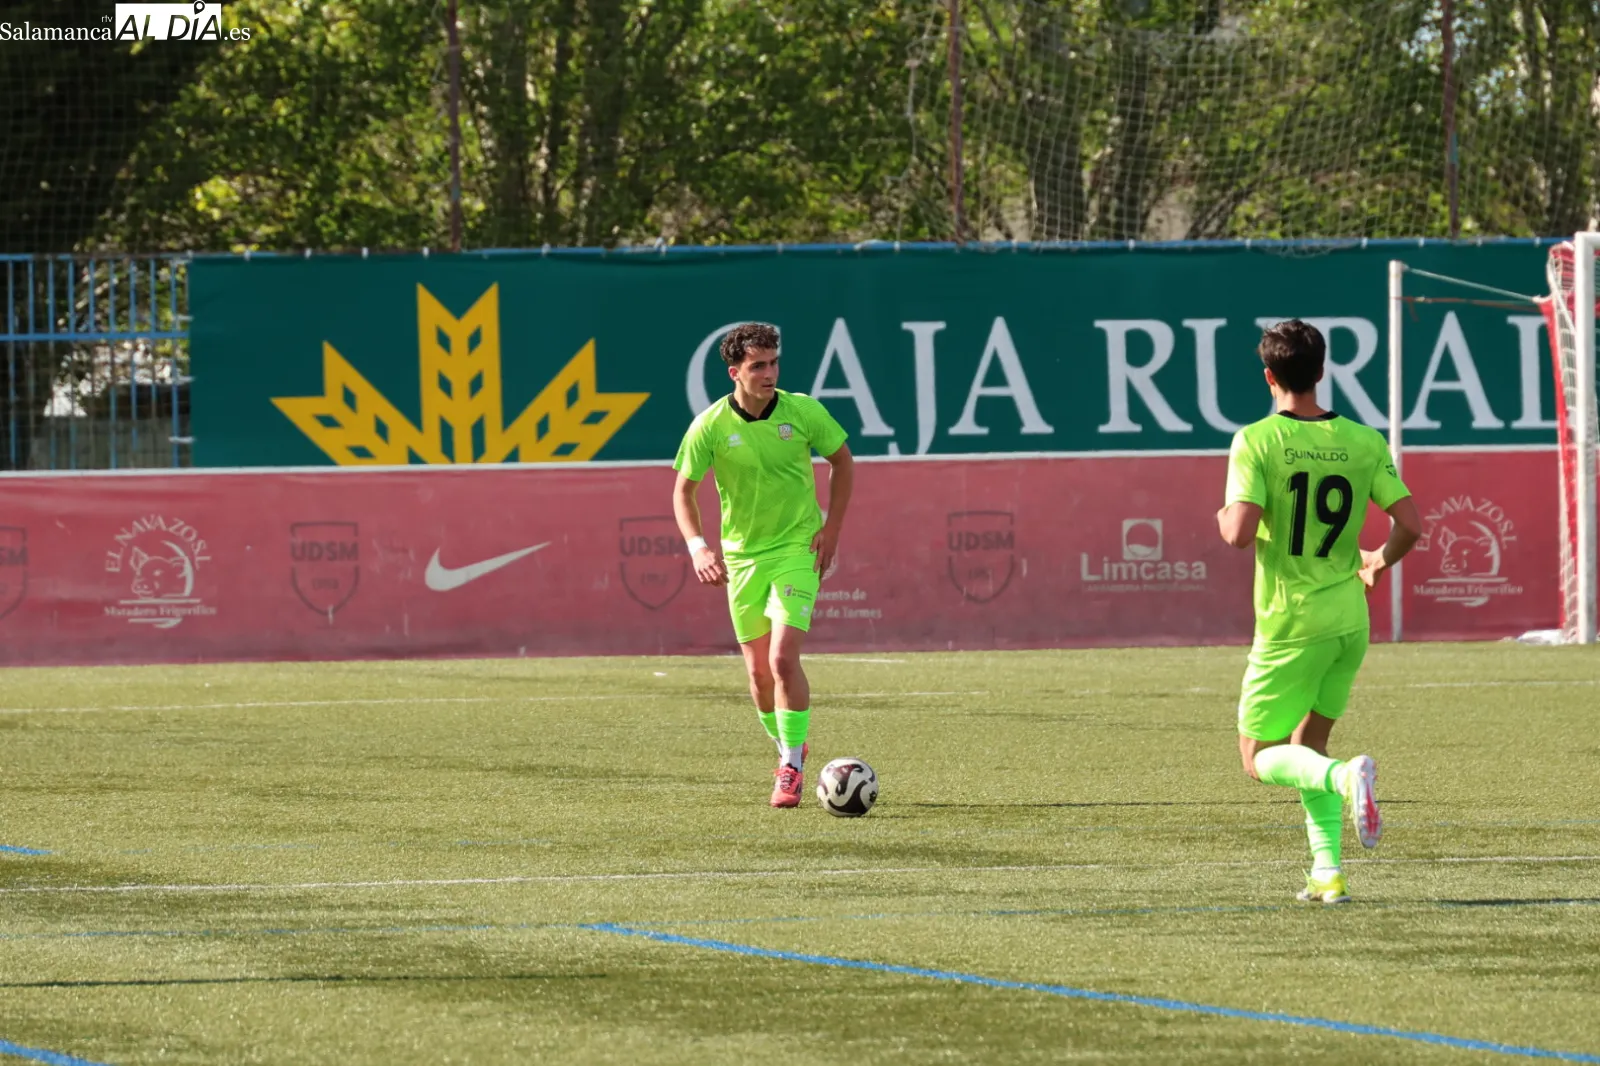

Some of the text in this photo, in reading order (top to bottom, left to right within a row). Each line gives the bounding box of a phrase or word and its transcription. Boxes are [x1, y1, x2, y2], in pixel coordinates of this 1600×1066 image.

[1289, 472, 1354, 558] 19
[290, 541, 358, 562] UDSM
[948, 531, 1014, 551] UDSM
[1081, 552, 1207, 581] Limcasa
